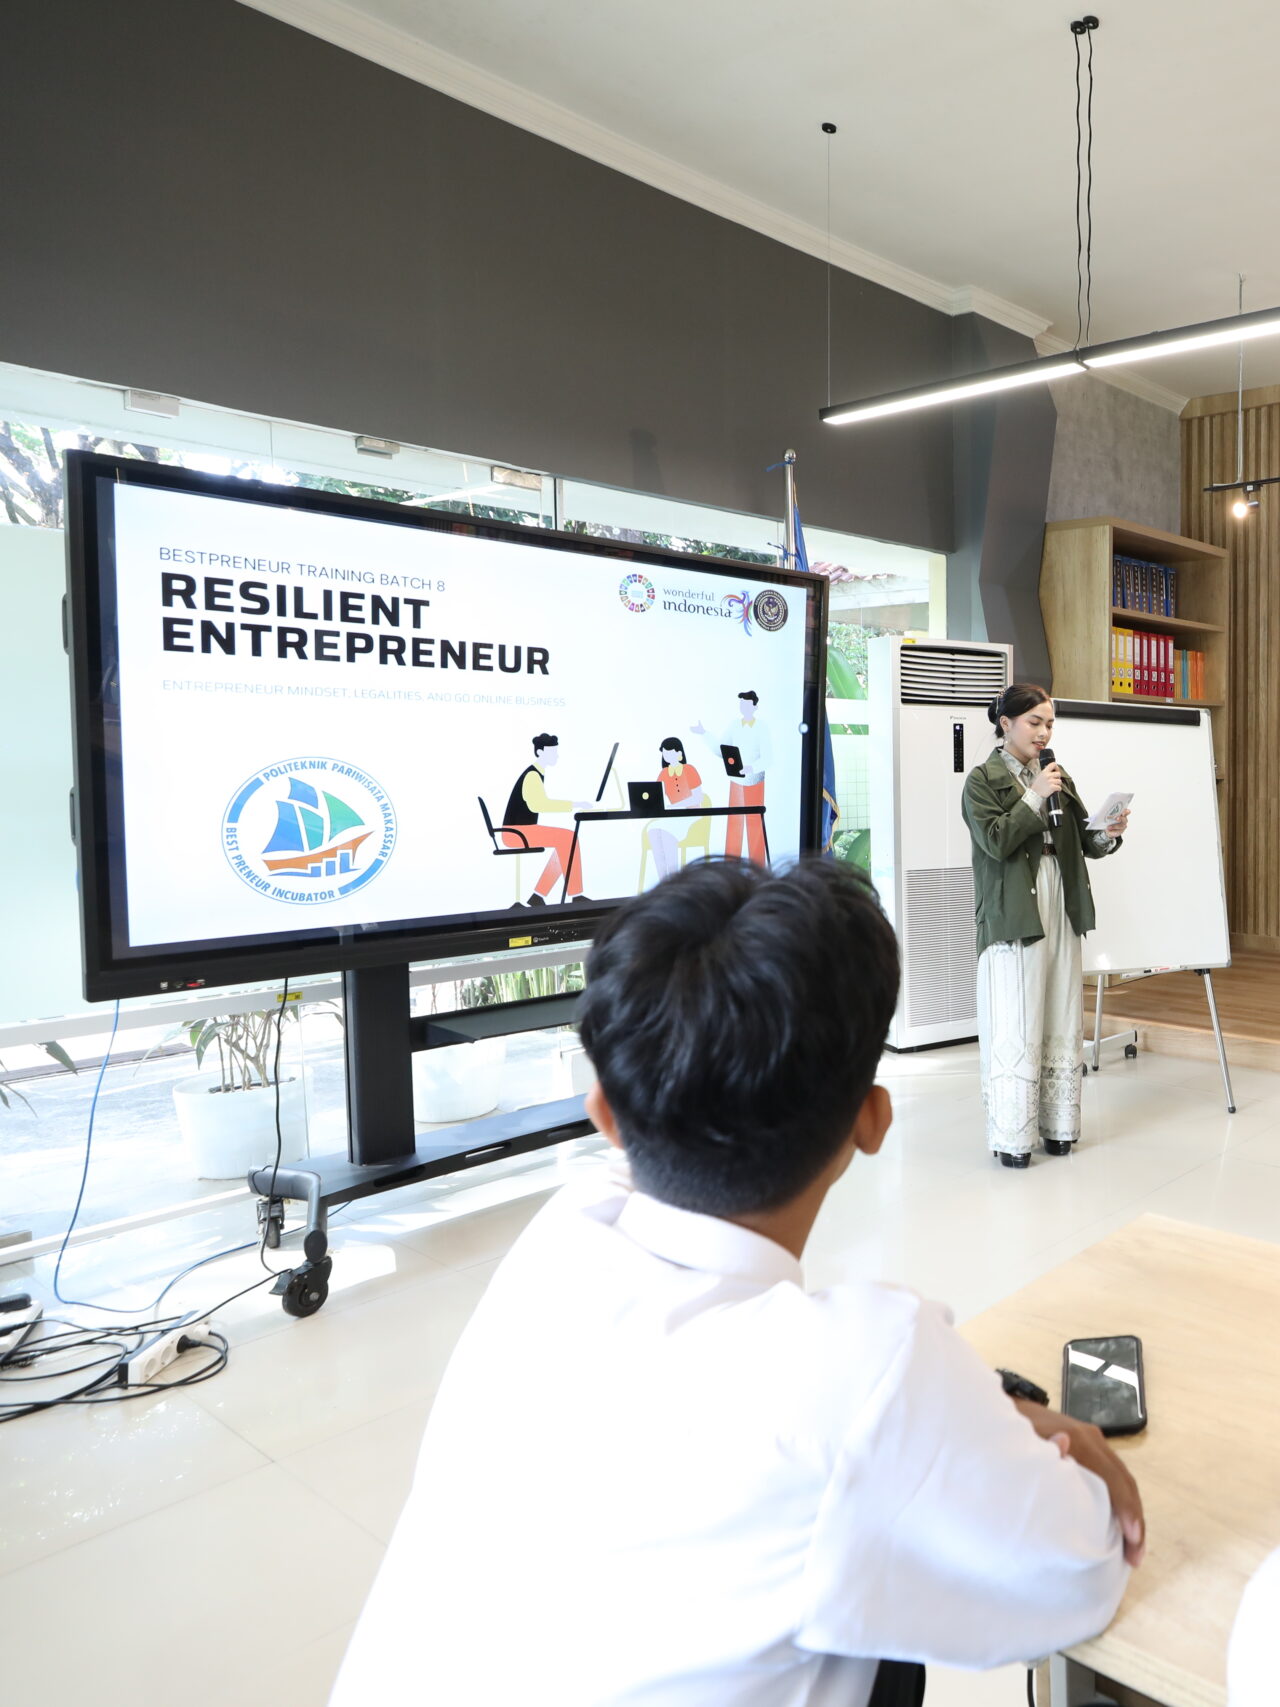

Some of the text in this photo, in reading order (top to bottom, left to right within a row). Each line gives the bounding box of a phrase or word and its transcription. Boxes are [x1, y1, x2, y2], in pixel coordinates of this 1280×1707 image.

[159, 546, 446, 592] BESTPRENEUR TRAINING BATCH 8
[663, 587, 715, 601] wonderful
[161, 571, 430, 629] RESILIENT
[663, 599, 732, 618] indonesia
[162, 616, 550, 675] ENTREPRENEUR
[162, 679, 284, 695] ENTREPRENEUR
[287, 685, 352, 699] MINDSET,
[427, 691, 452, 703] AND
[454, 693, 471, 704] GO
[473, 694, 513, 705] ONLINE
[515, 695, 566, 707] BUSINESS
[263, 760, 394, 858] POLITEKNIK PARIWISATA MAKASSAR
[226, 827, 335, 902] BEST PRENEUR INCUBATOR
